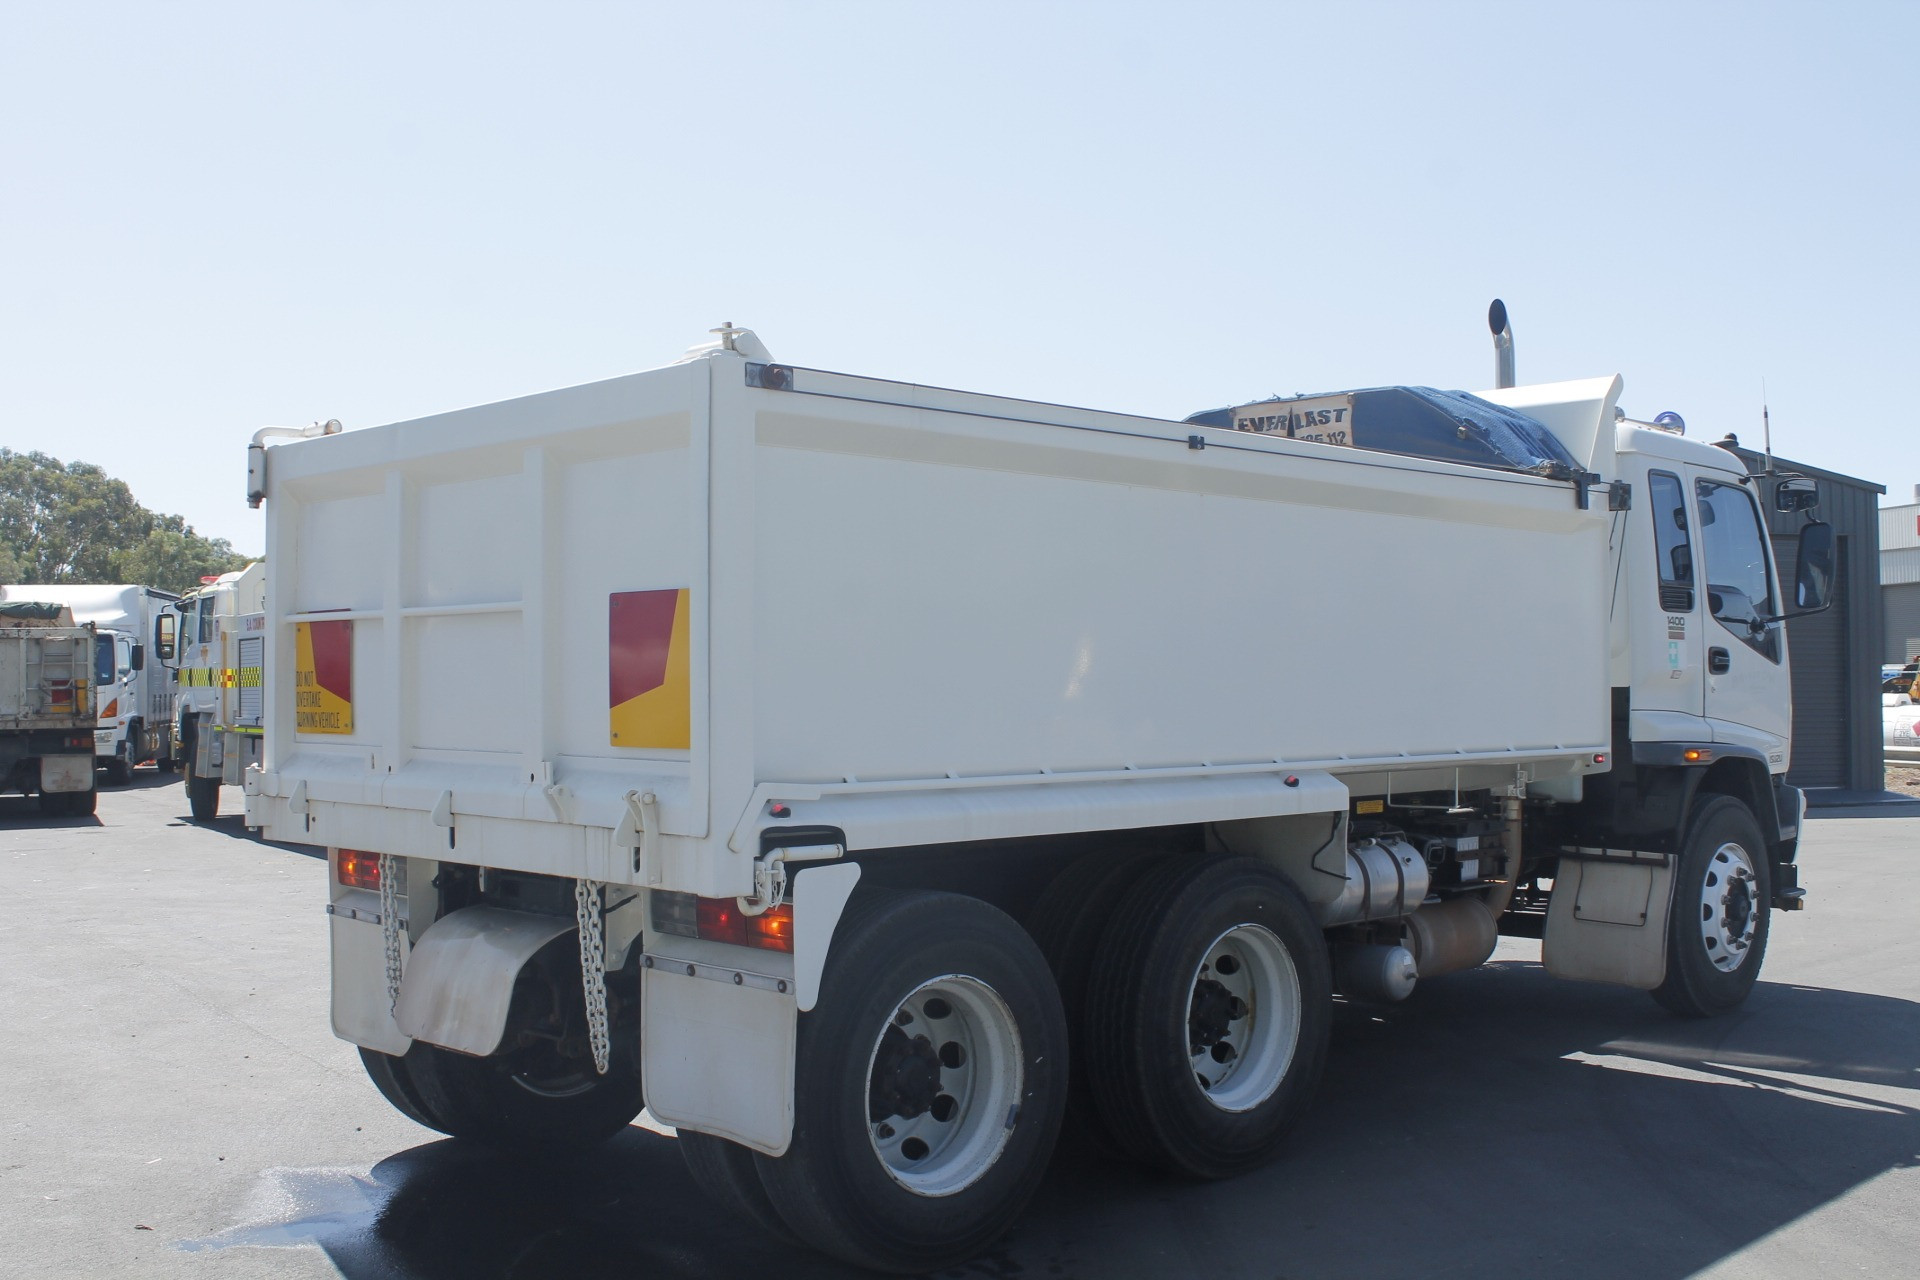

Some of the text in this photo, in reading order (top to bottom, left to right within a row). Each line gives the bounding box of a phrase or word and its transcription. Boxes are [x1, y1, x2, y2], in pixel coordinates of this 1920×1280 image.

[1667, 616, 1685, 626] 1400
[304, 671, 314, 687] NOT
[296, 691, 321, 707] OVERTAKE
[296, 711, 340, 728] TURNING VEHICLE
